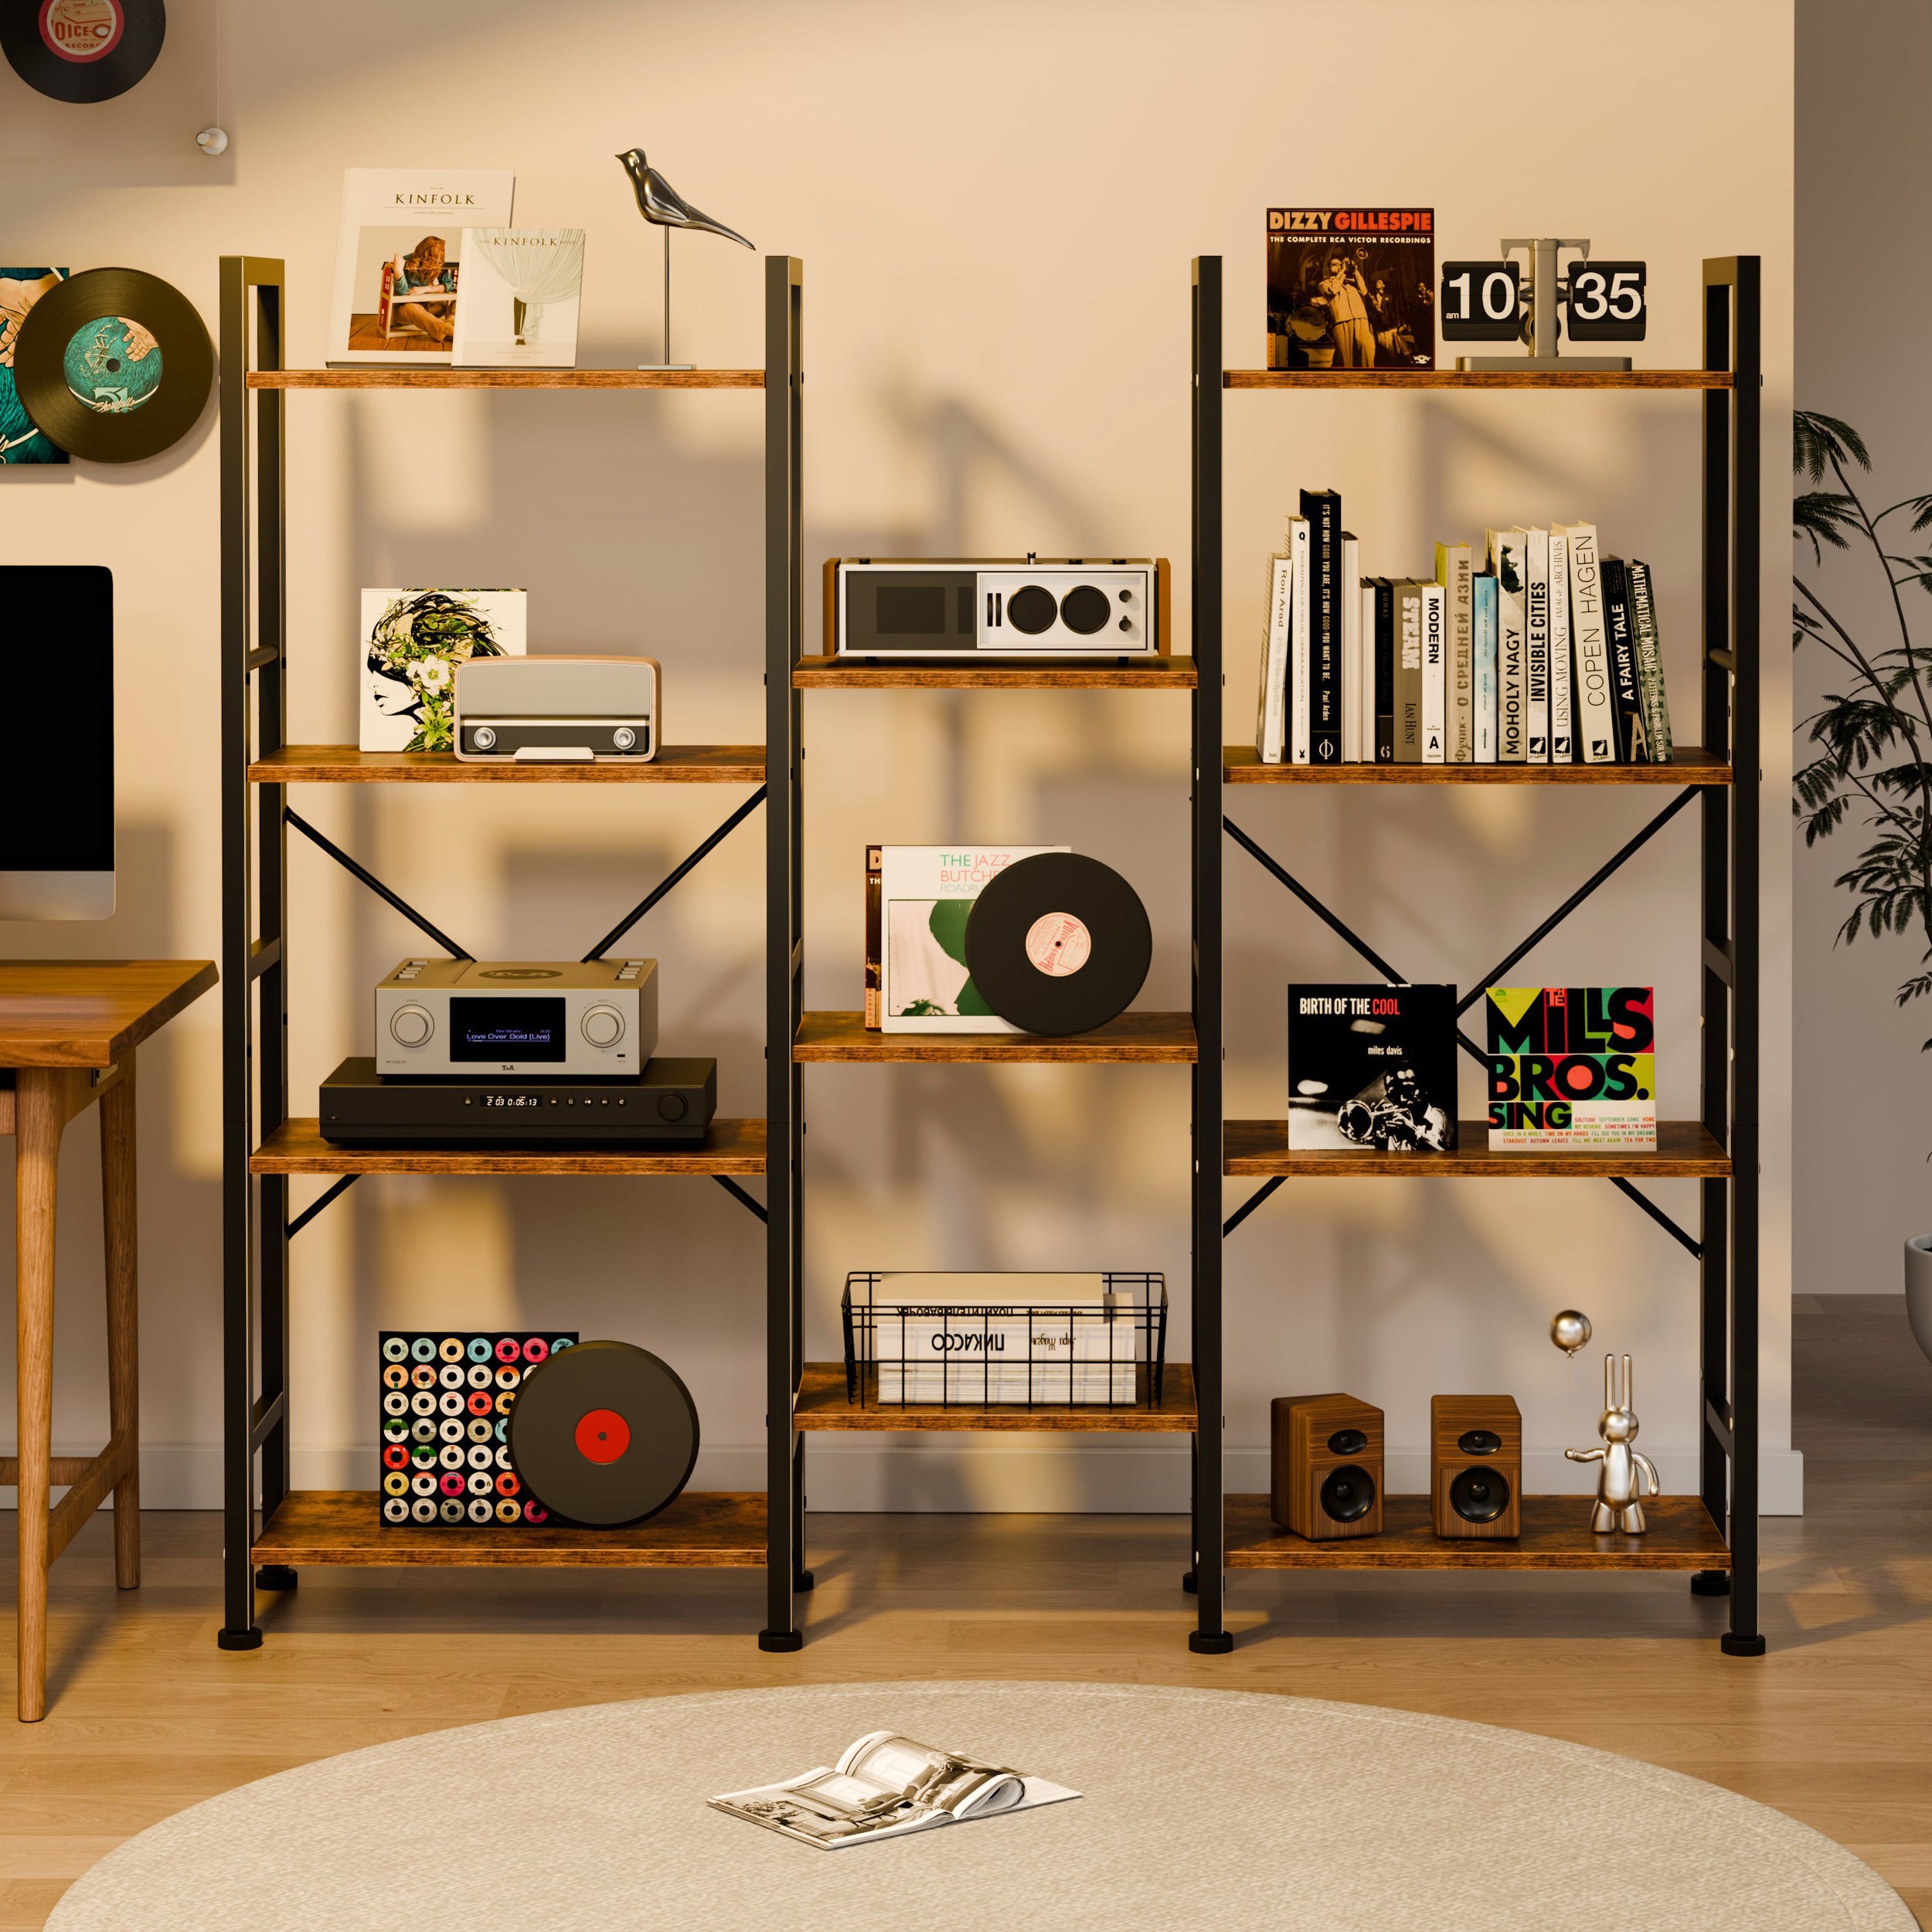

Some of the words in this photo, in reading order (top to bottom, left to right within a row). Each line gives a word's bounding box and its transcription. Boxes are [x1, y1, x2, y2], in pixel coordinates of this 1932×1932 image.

[395, 194, 475, 205] KINFOLK
[1270, 212, 1332, 230] DIZZY
[1334, 212, 1431, 230] GILLESPIE
[493, 237, 557, 247] KINFOLK
[1449, 272, 1515, 320] 10
[1574, 272, 1642, 320] 35
[1322, 504, 1331, 515] IT'S
[1322, 518, 1331, 528] NOT
[1322, 530, 1331, 543] HOW
[1322, 544, 1331, 559] GOOD
[1322, 561, 1331, 572] YOU
[1575, 536, 1598, 614] HAGEN
[1321, 574, 1331, 587] ARE,
[1458, 560, 1468, 605] АЗИИ
[1322, 589, 1331, 600] IT'S
[1531, 582, 1546, 628] CITIES
[1277, 593, 1286, 628] Arad
[1322, 601, 1331, 614] HOW
[1631, 565, 1649, 635] MATHEMATICAL
[1641, 637, 1657, 672] MOSAIC
[1402, 597, 1420, 669] STEAM
[1428, 598, 1439, 663] MODERN
[1611, 603, 1628, 641] TALE
[1322, 632, 1331, 644] YOU
[1322, 645, 1331, 662] WANT
[1454, 614, 1468, 689] СРЕДНЕЙ
[1507, 629, 1519, 675] NAGY
[1555, 627, 1567, 682] MOVING
[1322, 672, 1331, 682] BE.
[1531, 633, 1546, 702] INVISIBLE
[1583, 628, 1606, 706] COPEN
[1616, 645, 1632, 686] FAIRY
[1322, 691, 1331, 703] Paul
[1621, 689, 1634, 700] A
[1648, 678, 1658, 707] PATTERNS
[1322, 705, 1331, 721] Arden
[1405, 703, 1416, 719] IAN
[1507, 682, 1519, 754] MOHOLY
[1556, 688, 1568, 727] USING
[1405, 720, 1416, 745] HUNT
[1652, 714, 1663, 740] PROBLEM
[1430, 736, 1439, 749] A
[1455, 723, 1471, 761] Фучик
[940, 855, 971, 866] THE
[974, 855, 1011, 869] JAZZ
[1300, 998, 1332, 1015] BIRTH
[1334, 998, 1348, 1015] OF
[1349, 998, 1371, 1015] THE
[1372, 998, 1400, 1015] COOL
[1486, 987, 1654, 1054] MILLS
[1368, 1046, 1385, 1056] miles
[1386, 1046, 1403, 1056] davis
[1488, 1054, 1649, 1101] BROS.
[1488, 1101, 1572, 1130] SING
[932, 1334, 1005, 1351] ПИКАССО
